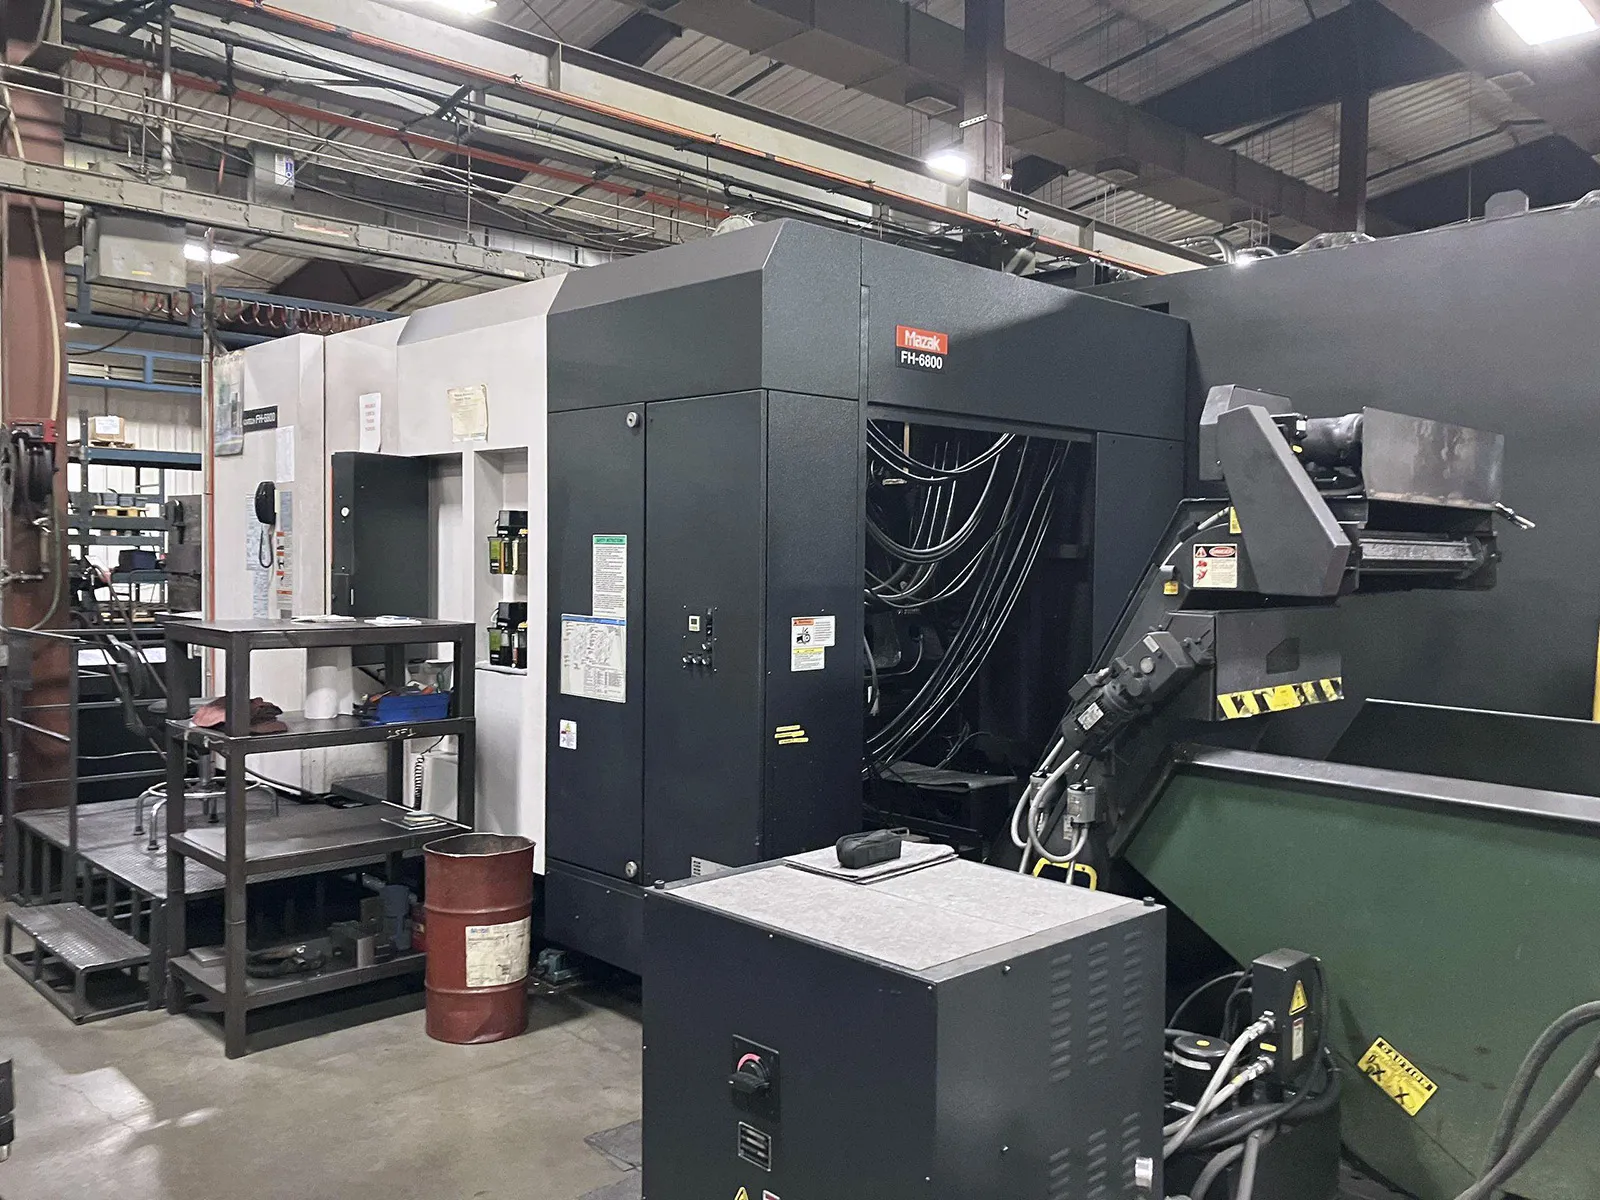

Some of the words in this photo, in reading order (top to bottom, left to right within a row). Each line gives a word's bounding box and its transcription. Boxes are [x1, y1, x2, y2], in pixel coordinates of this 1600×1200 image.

[904, 329, 941, 351] Mazak
[901, 350, 943, 370] FH-6800
[1380, 1044, 1430, 1089] CAUTION
